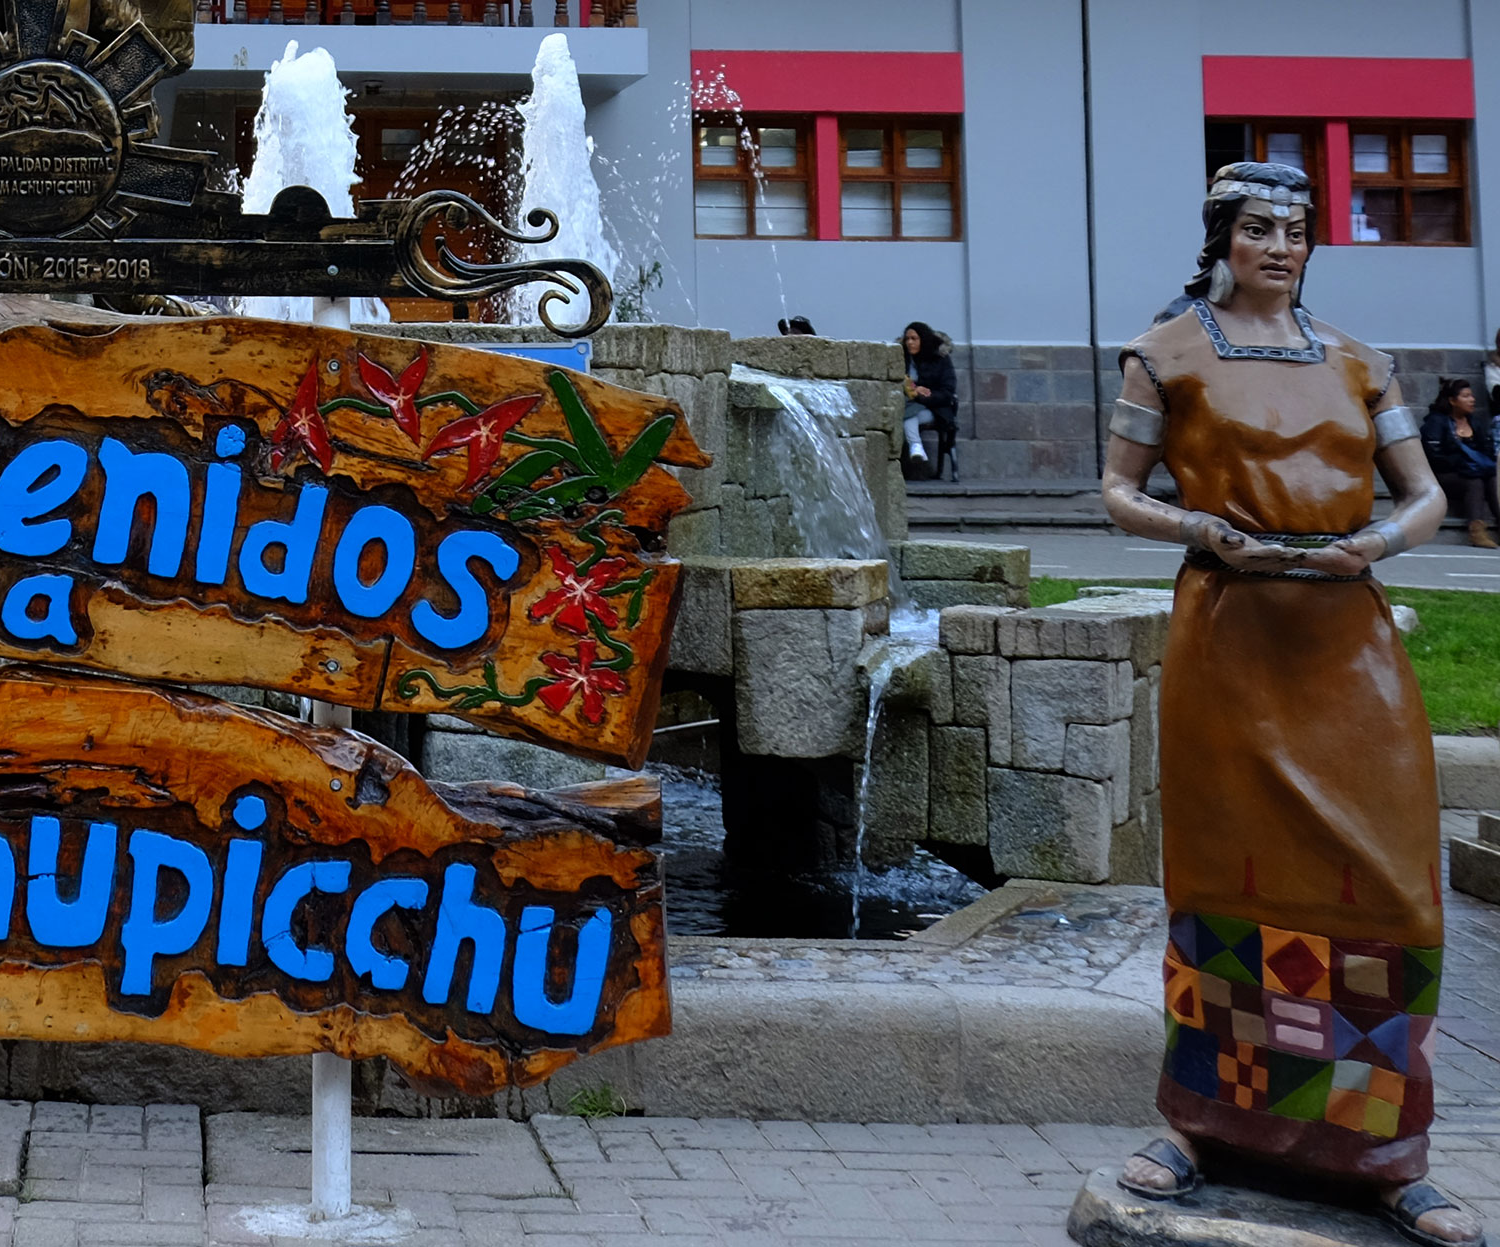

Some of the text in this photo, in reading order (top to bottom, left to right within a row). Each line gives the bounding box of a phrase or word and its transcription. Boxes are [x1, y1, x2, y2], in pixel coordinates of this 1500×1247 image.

[53, 156, 114, 173] DISTRITAL
[0, 180, 92, 196] MACHUPICCHU
[2, 575, 76, 644] a
